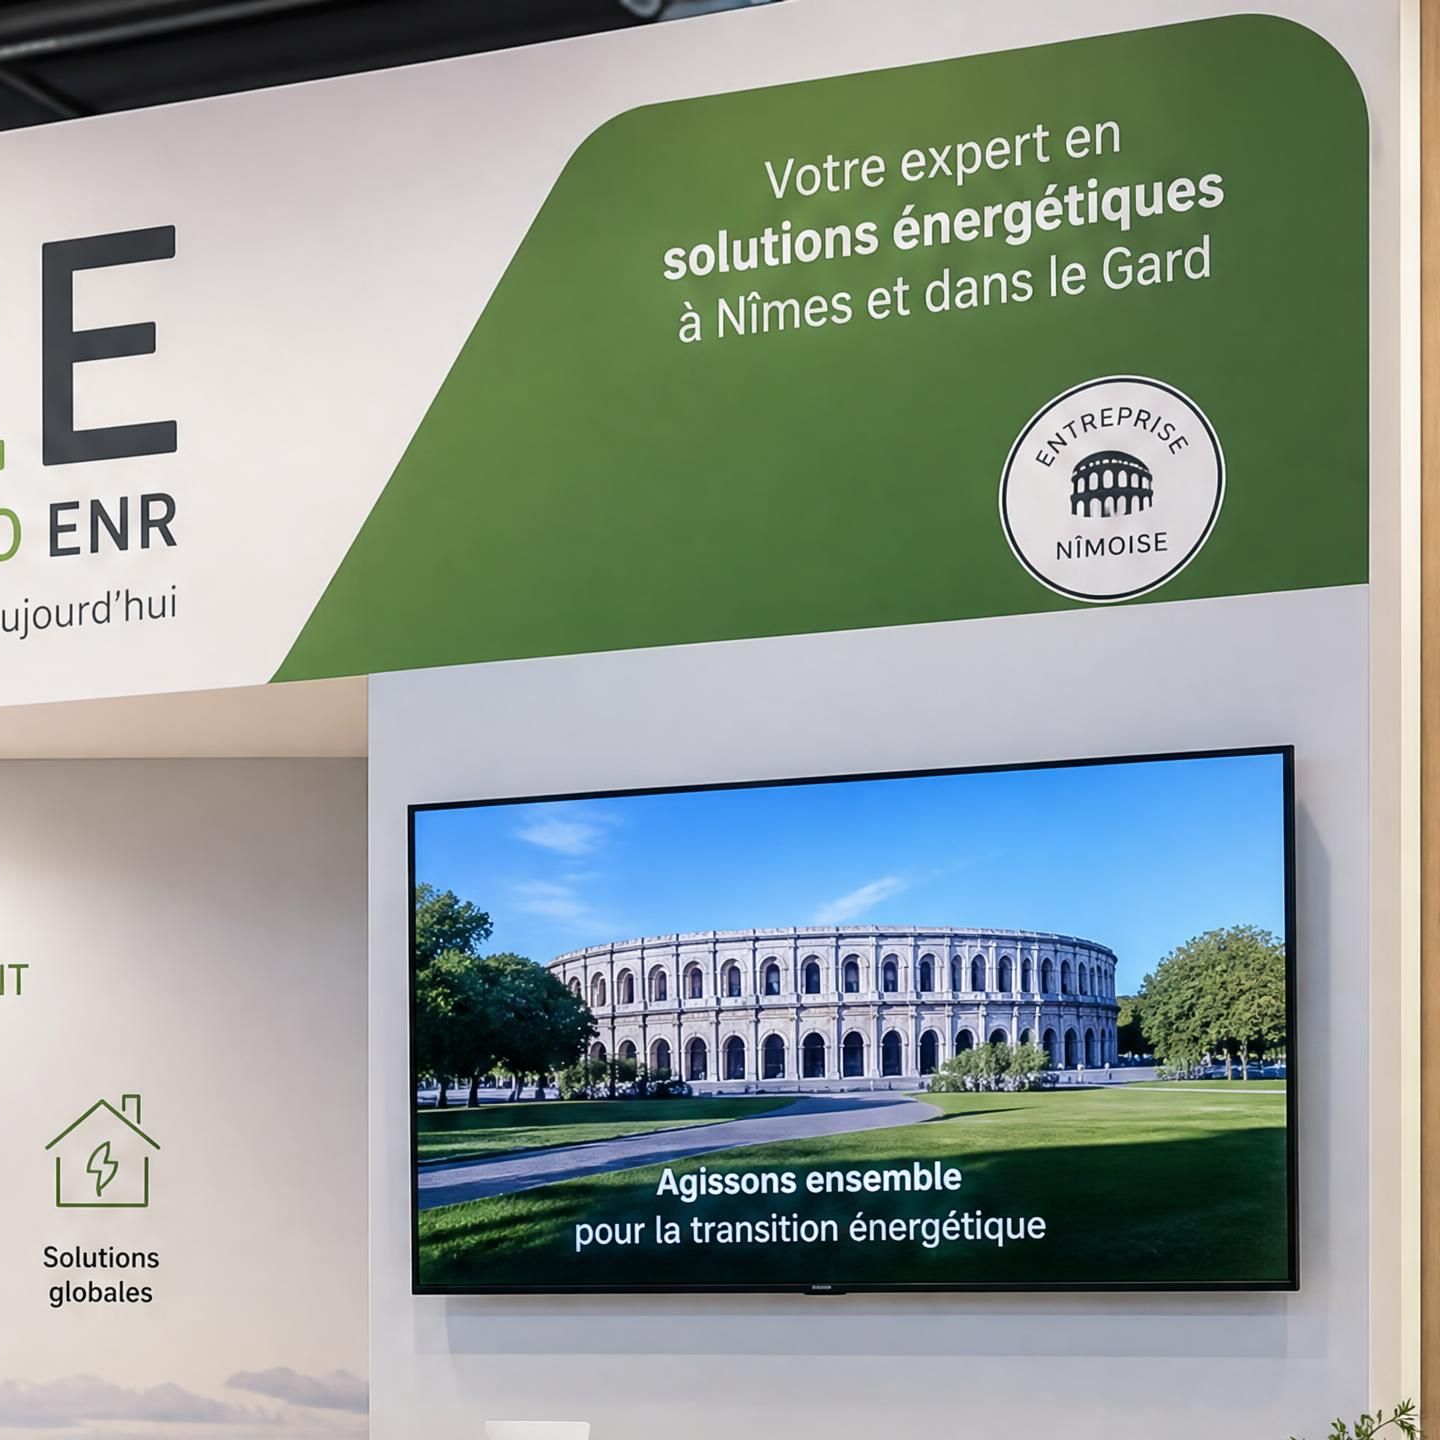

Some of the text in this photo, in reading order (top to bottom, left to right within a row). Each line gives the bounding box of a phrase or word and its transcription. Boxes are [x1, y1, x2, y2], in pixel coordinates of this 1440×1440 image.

[765, 121, 1119, 198] Votre expert en
[664, 172, 1225, 280] solutions énergétiques
[679, 235, 1209, 342] à Nîmes et dans le Gard
[1035, 407, 1189, 468] ENTREPRISE
[50, 493, 177, 557] ENR
[1057, 532, 1167, 560] NÎMOISE
[657, 1161, 961, 1202] Agissons ensemble
[575, 1210, 1046, 1252] pour la transition énergétique
[44, 1246, 159, 1268] Solutions
[50, 1281, 152, 1308] globales
